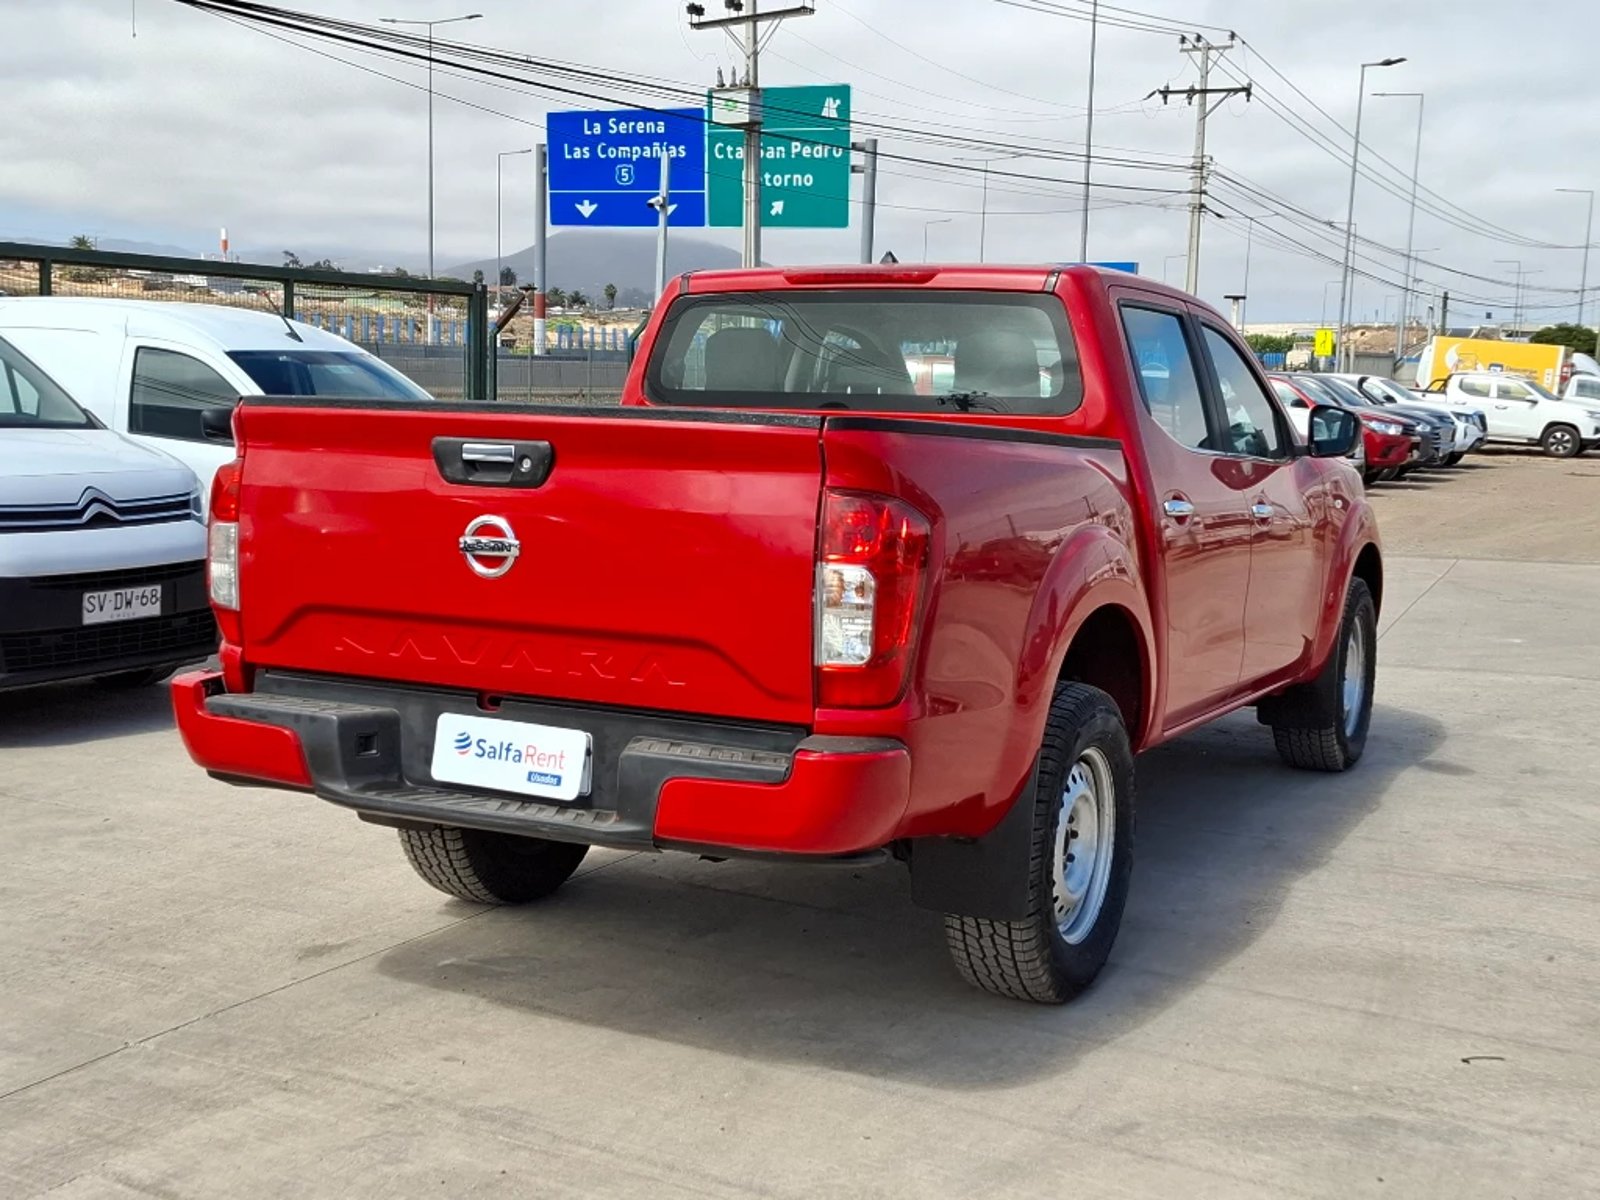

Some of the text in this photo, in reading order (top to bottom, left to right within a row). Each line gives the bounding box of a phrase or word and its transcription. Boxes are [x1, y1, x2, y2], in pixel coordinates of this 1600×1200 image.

[583, 118, 665, 135] La Serena
[563, 143, 590, 159] Las
[714, 141, 843, 159] Cta an Pedro
[621, 168, 630, 181] 5
[742, 171, 814, 187] torno
[475, 738, 566, 770] SalfaRent
